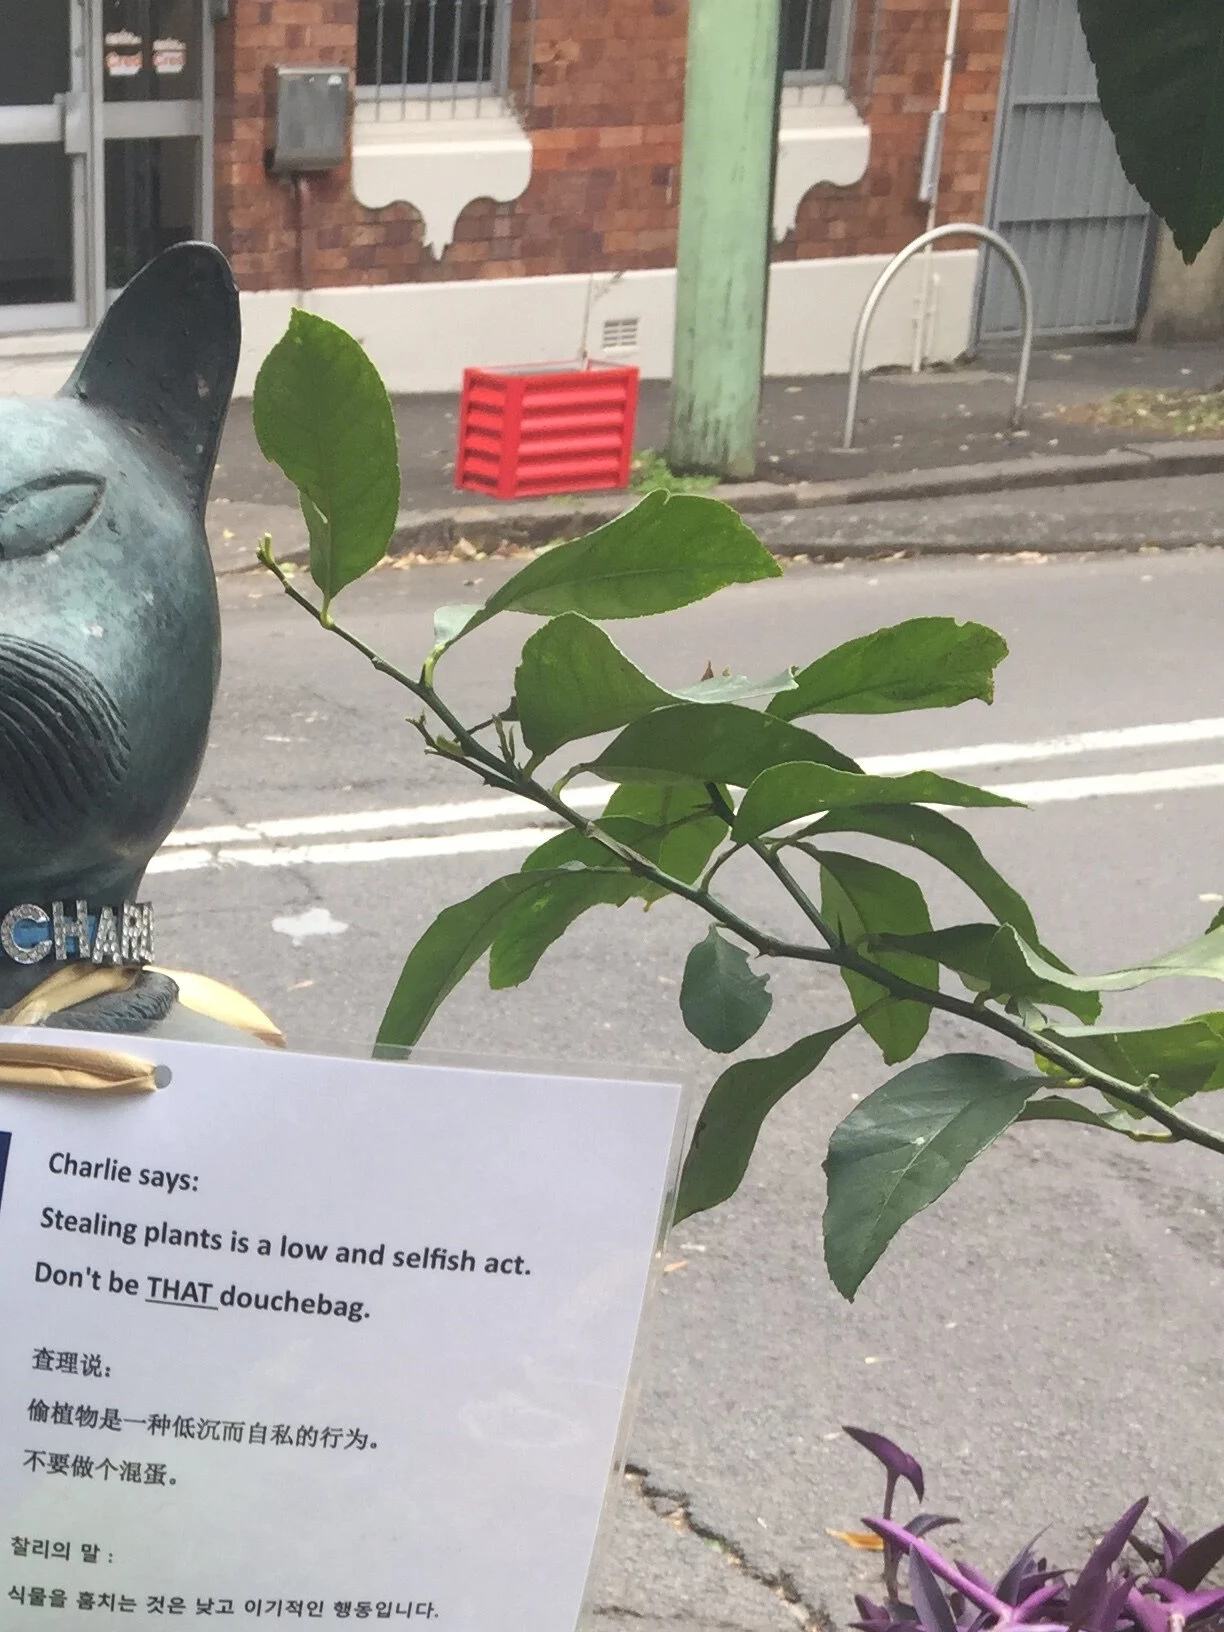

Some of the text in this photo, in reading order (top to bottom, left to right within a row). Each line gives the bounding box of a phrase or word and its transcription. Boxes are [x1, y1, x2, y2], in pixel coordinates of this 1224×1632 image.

[48, 1151, 199, 1195] Charlie says:
[39, 1206, 532, 1276] Stealing plants is a low and selfish act.
[34, 1260, 371, 1324] Don't be THAT douchebag.
[26, 1397, 378, 1451] 偷植物是一种低沉而自私的行为。
[22, 1448, 177, 1487] 不要做个混蛋。
[10, 1535, 71, 1562] 찰리의
[80, 1543, 101, 1564] 말
[7, 1584, 440, 1620] 식물을 훔치는 것은 낮고 이기적인 행동입니다.
